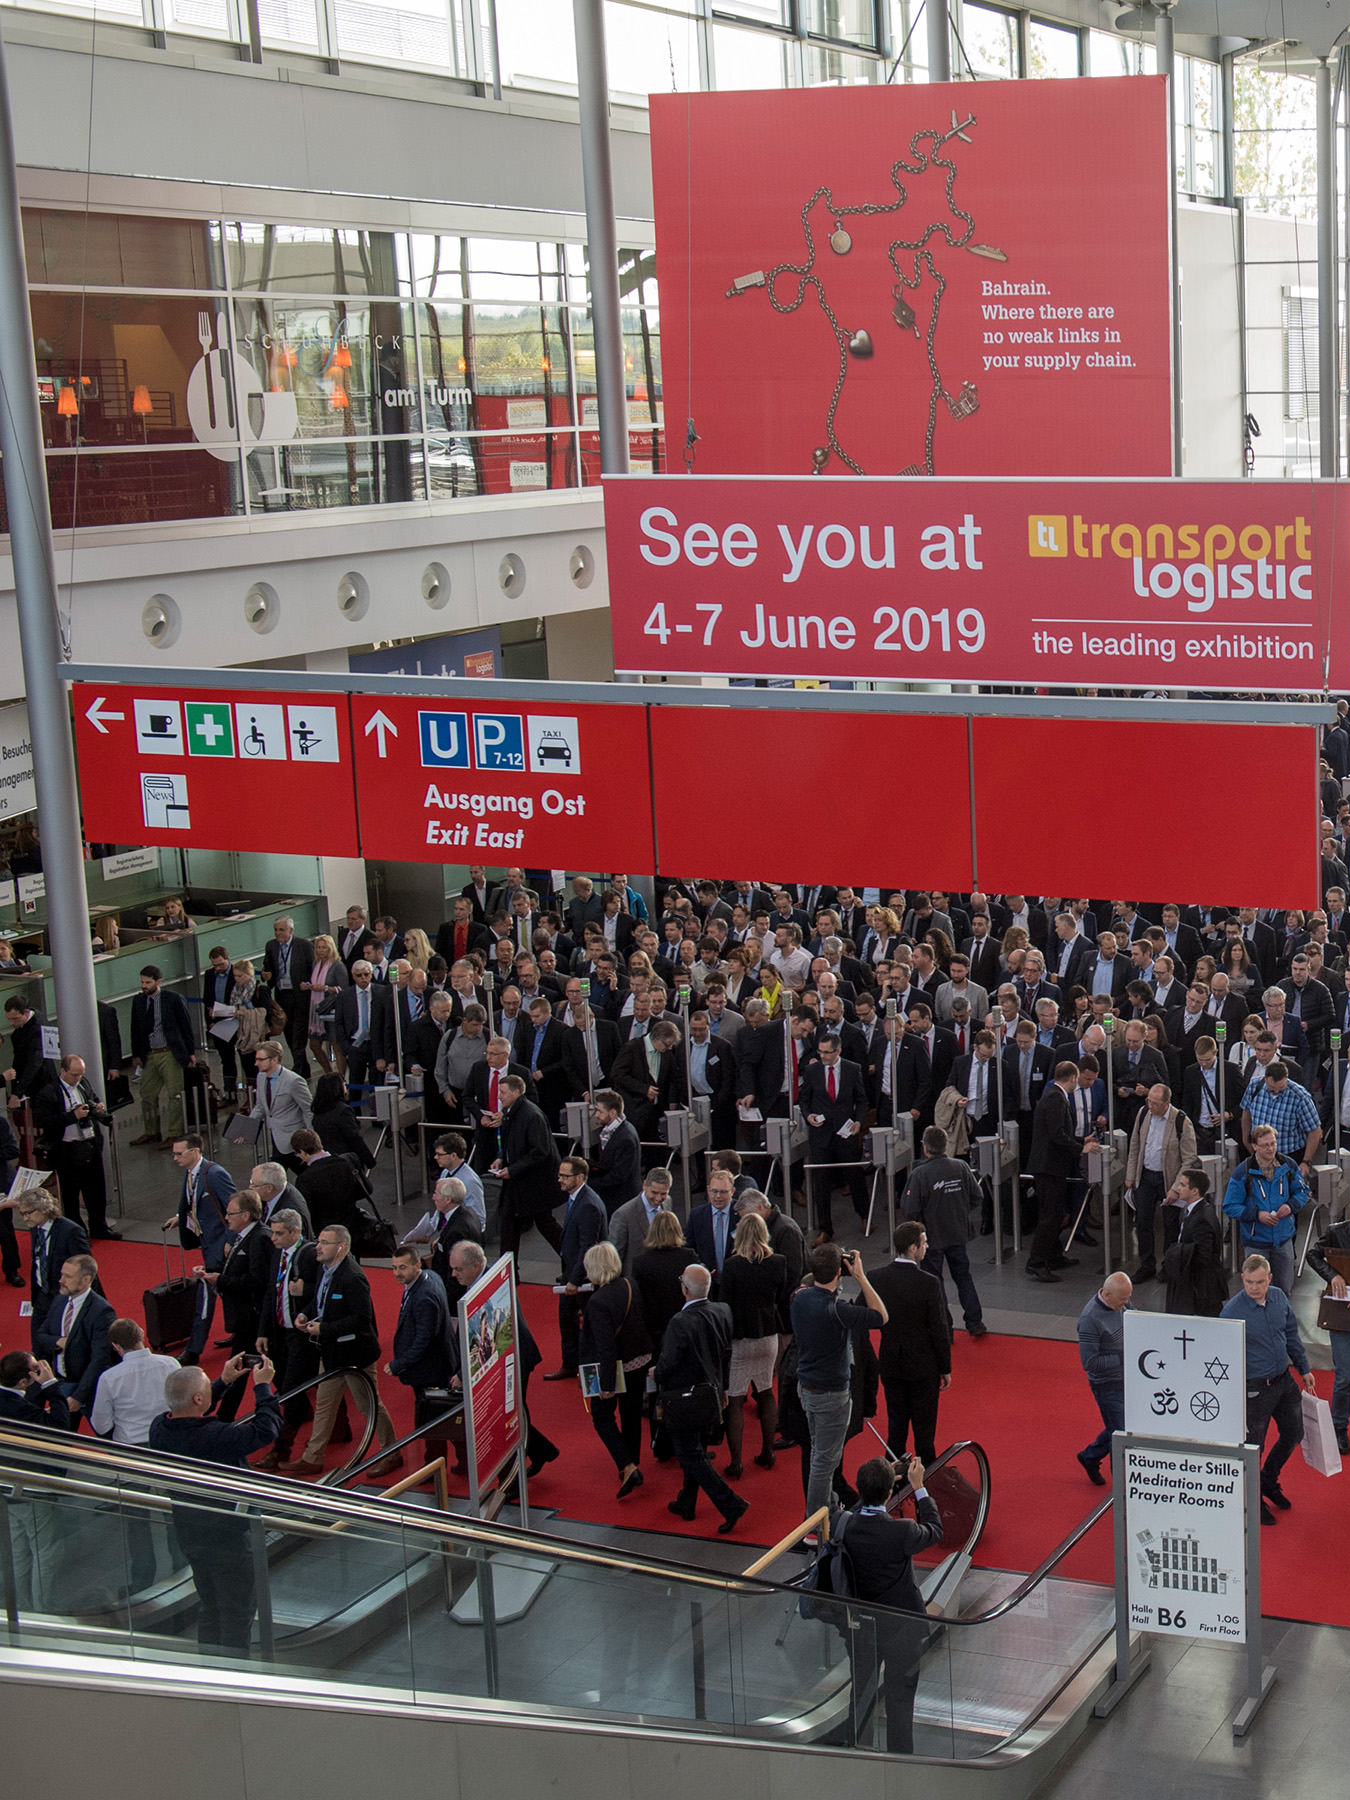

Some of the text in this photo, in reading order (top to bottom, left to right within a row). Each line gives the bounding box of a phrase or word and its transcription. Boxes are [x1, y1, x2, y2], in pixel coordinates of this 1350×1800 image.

[981, 280, 1051, 296] Bahrain.
[981, 304, 1115, 320] Where there are
[983, 327, 1121, 344] no weak links in
[982, 351, 1137, 371] your supply chain.
[384, 379, 473, 408] am Turm
[639, 506, 984, 583] See you at
[1073, 514, 1312, 573] transport
[1133, 556, 1313, 612] logistic
[643, 602, 986, 653] 4-7 June 2019
[1032, 631, 1314, 662] the leading exhibition
[2, 738, 33, 761] Besuche
[429, 718, 523, 766] U P 7-12
[147, 789, 175, 801] News
[424, 784, 586, 820] Ausgang Ost
[426, 820, 525, 849] Exit East
[1128, 1454, 1240, 1477] Räume der Stille
[1129, 1471, 1234, 1494] Meditation and
[1130, 1487, 1225, 1509] Prayer Rooms
[1132, 1604, 1240, 1628] Halle B6 1.OG
[1132, 1615, 1240, 1635] Hall First Floor
